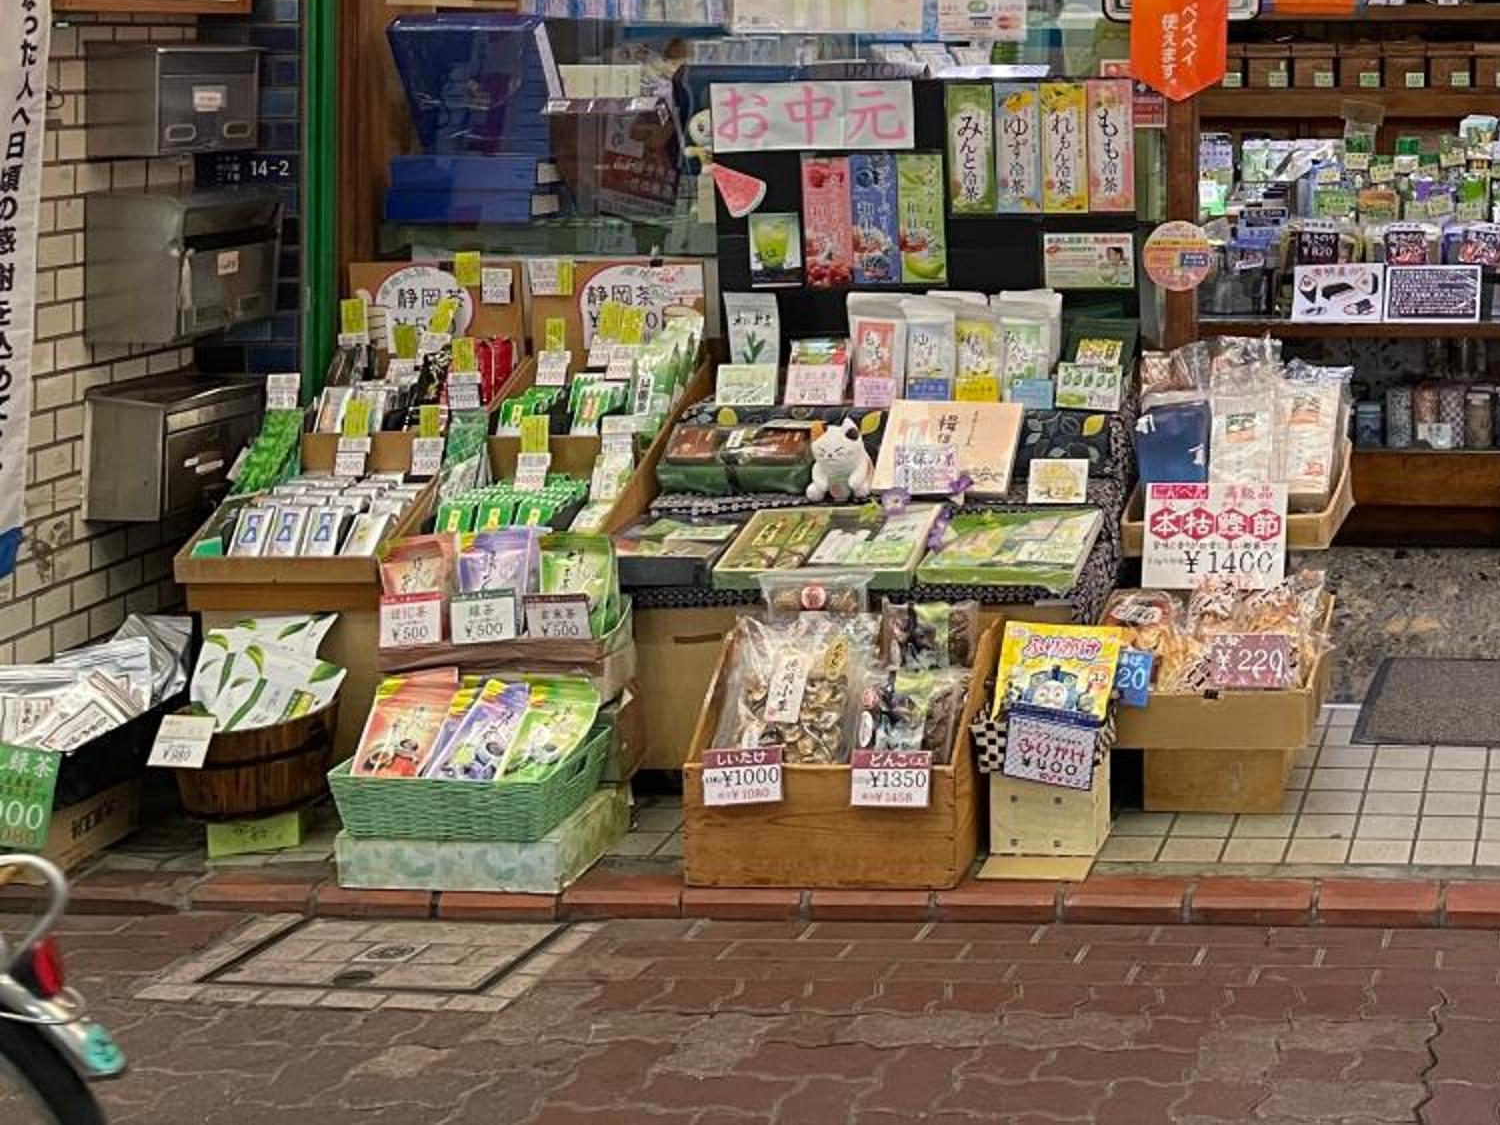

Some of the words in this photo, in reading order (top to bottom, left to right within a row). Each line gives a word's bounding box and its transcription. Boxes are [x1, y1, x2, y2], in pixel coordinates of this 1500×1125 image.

[717, 87, 908, 144] お中元
[250, 160, 290, 177] 14-2
[0, 751, 54, 779] 緑茶
[716, 751, 767, 766] しいたけ
